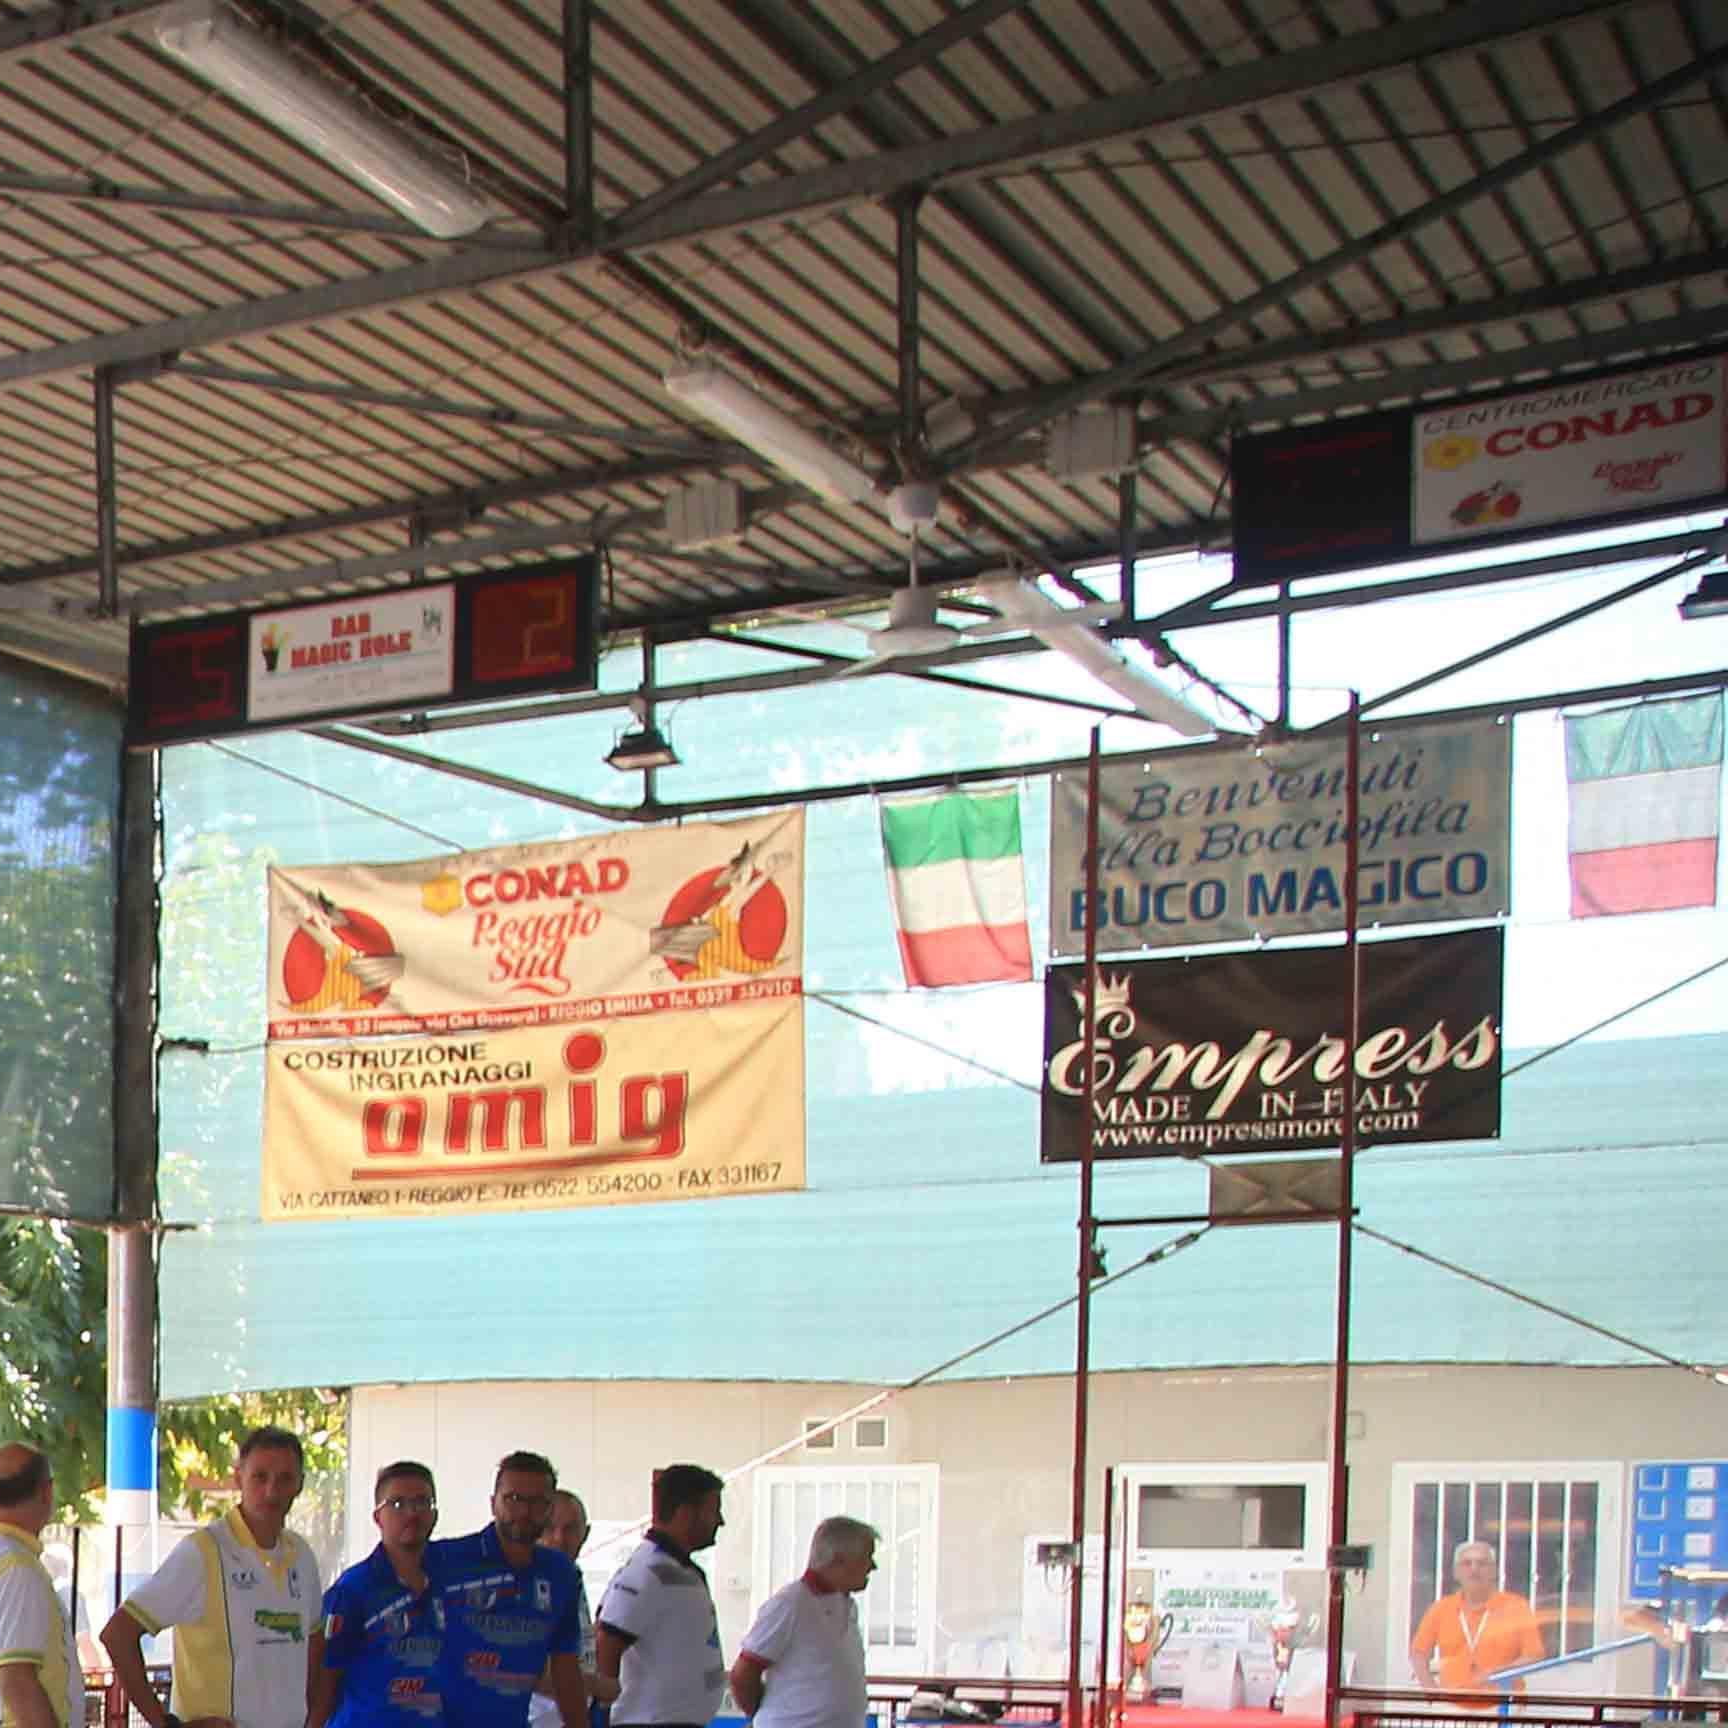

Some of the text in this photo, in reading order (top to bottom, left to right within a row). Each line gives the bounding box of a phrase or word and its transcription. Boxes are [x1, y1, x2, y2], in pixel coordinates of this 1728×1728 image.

[1423, 366, 1714, 434] CENTROMERCATO
[1486, 393, 1714, 457] CONAD
[331, 613, 371, 638] BAR
[290, 640, 352, 669] MAGIC
[464, 857, 631, 908] CONAD
[1071, 851, 1489, 932] BUCO MAGICO
[471, 899, 604, 950] Reggio
[489, 941, 572, 997] Sud
[283, 1041, 487, 1071] COSTRUZIONE
[350, 1060, 532, 1091] INGRANAGGI
[1048, 1003, 1499, 1120] Empress
[1092, 1095, 1192, 1124] MADE
[1260, 1091, 1296, 1118] IN
[279, 1193, 304, 1209] VIA
[309, 1189, 389, 1208] CATTANEO
[533, 1177, 579, 1197] 0522
[586, 1172, 663, 1194] 554200
[677, 1168, 714, 1188] FAX
[719, 1162, 783, 1185] 331167
